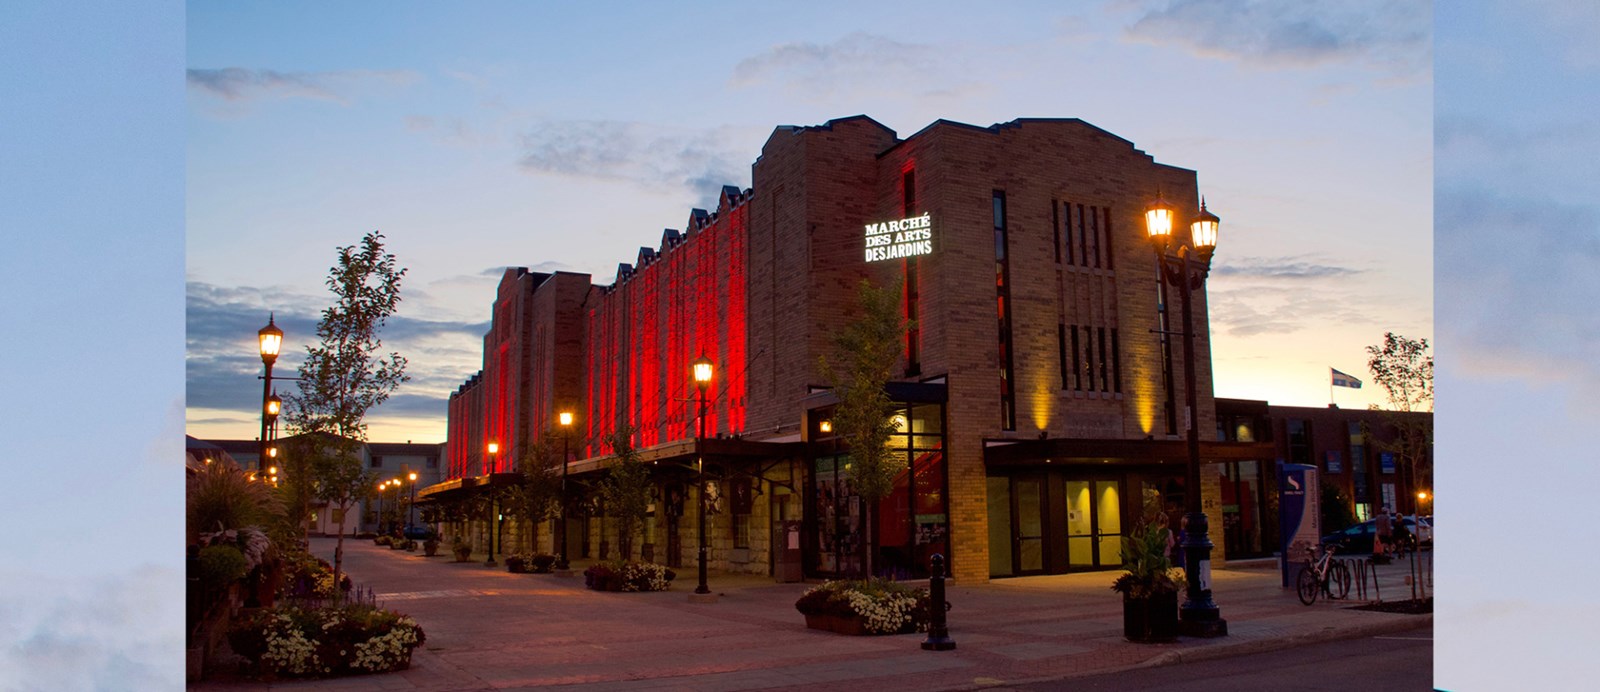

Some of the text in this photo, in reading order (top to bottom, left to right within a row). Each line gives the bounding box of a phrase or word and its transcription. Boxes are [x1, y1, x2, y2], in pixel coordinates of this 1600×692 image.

[865, 212, 931, 236] MARCHÉ
[865, 228, 932, 248] DES ARTS
[865, 240, 932, 262] DESJARDINS
